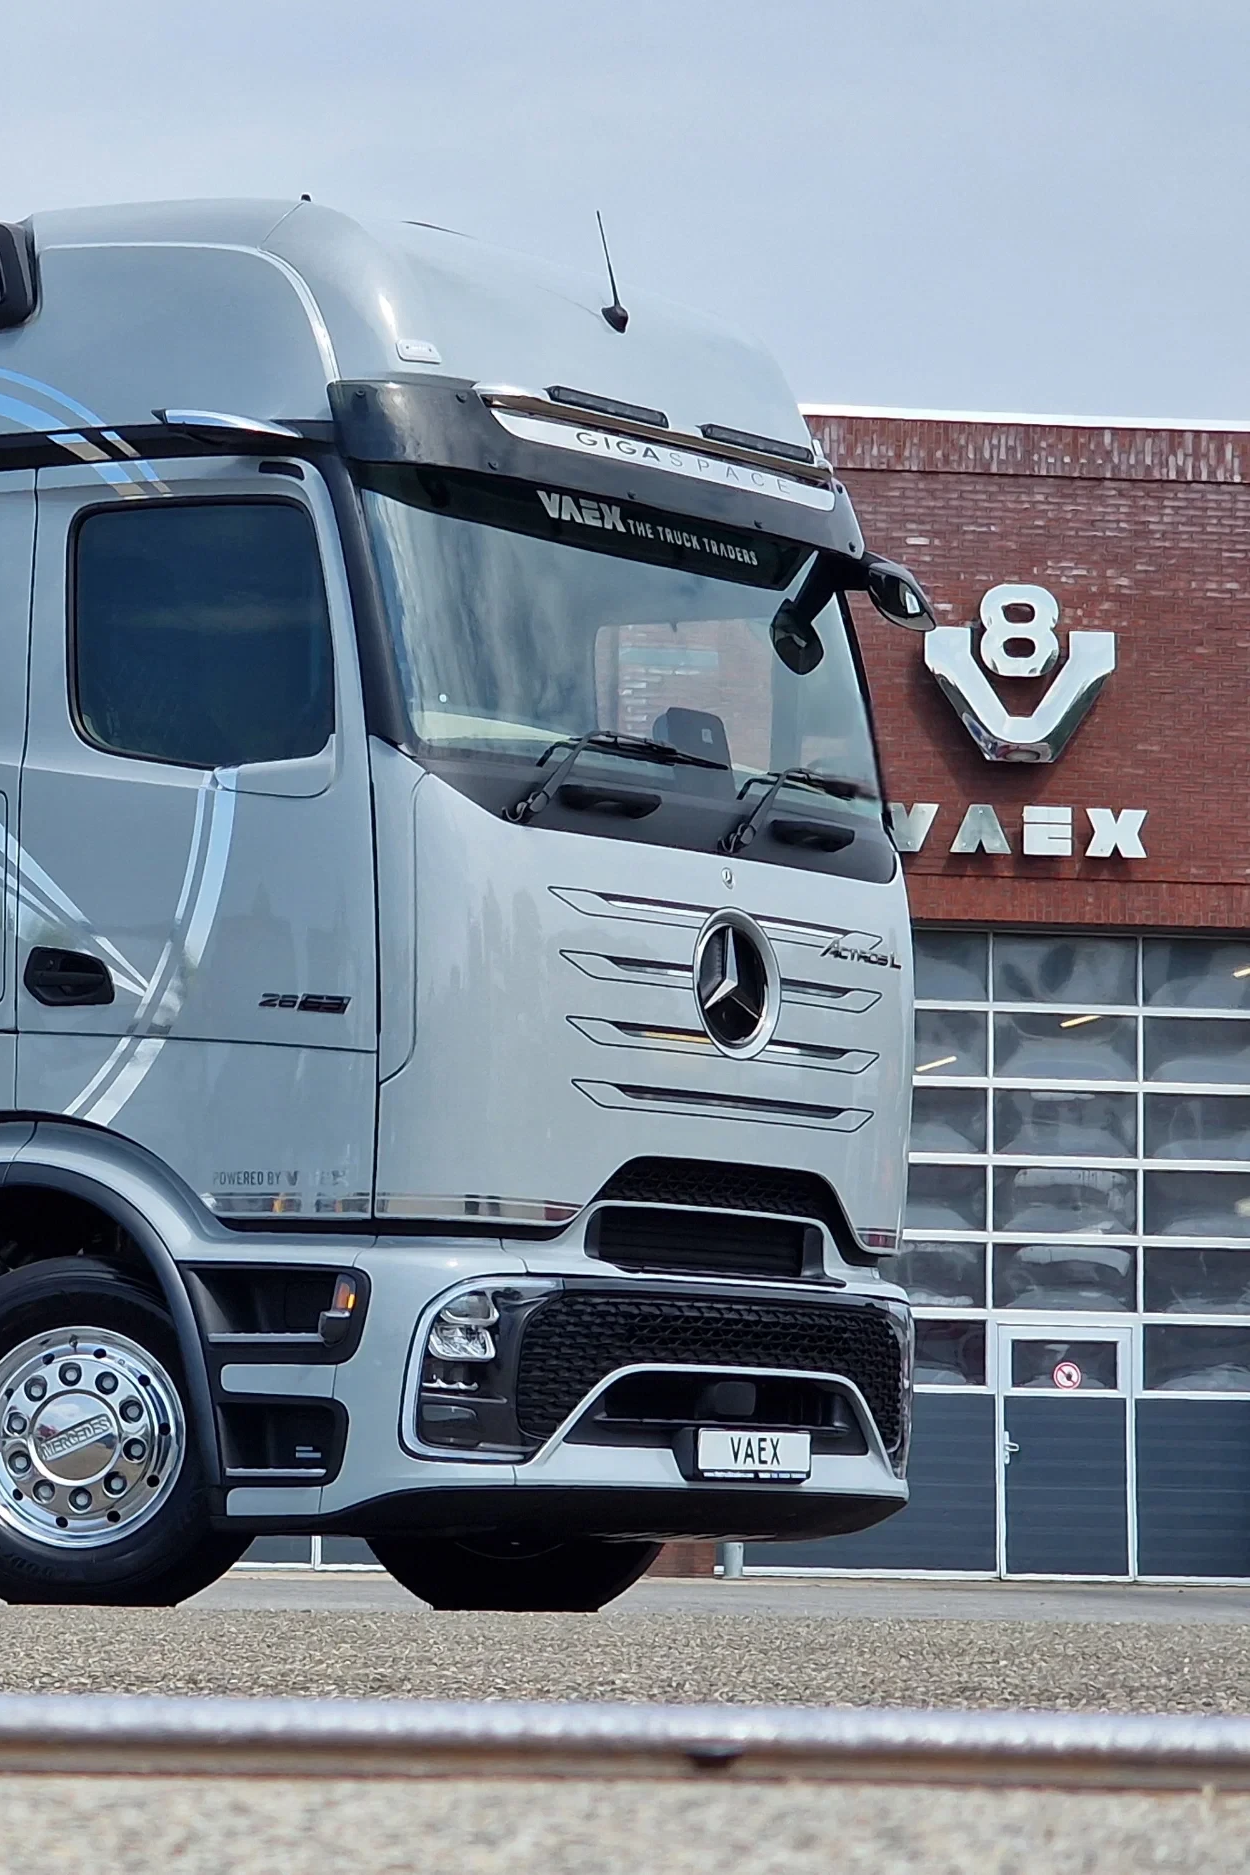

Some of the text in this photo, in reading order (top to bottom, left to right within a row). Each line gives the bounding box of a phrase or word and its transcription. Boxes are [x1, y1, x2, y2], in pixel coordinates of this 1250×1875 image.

[575, 431, 791, 495] GIGASPACE
[536, 490, 759, 566] VAEX THE TRUCK TRADERS
[890, 802, 1148, 859] VAEX
[213, 1171, 264, 1186] POWERED
[267, 1171, 282, 1186] BY
[39, 1416, 110, 1460] MERCEDES
[730, 1436, 781, 1466] VAEX
